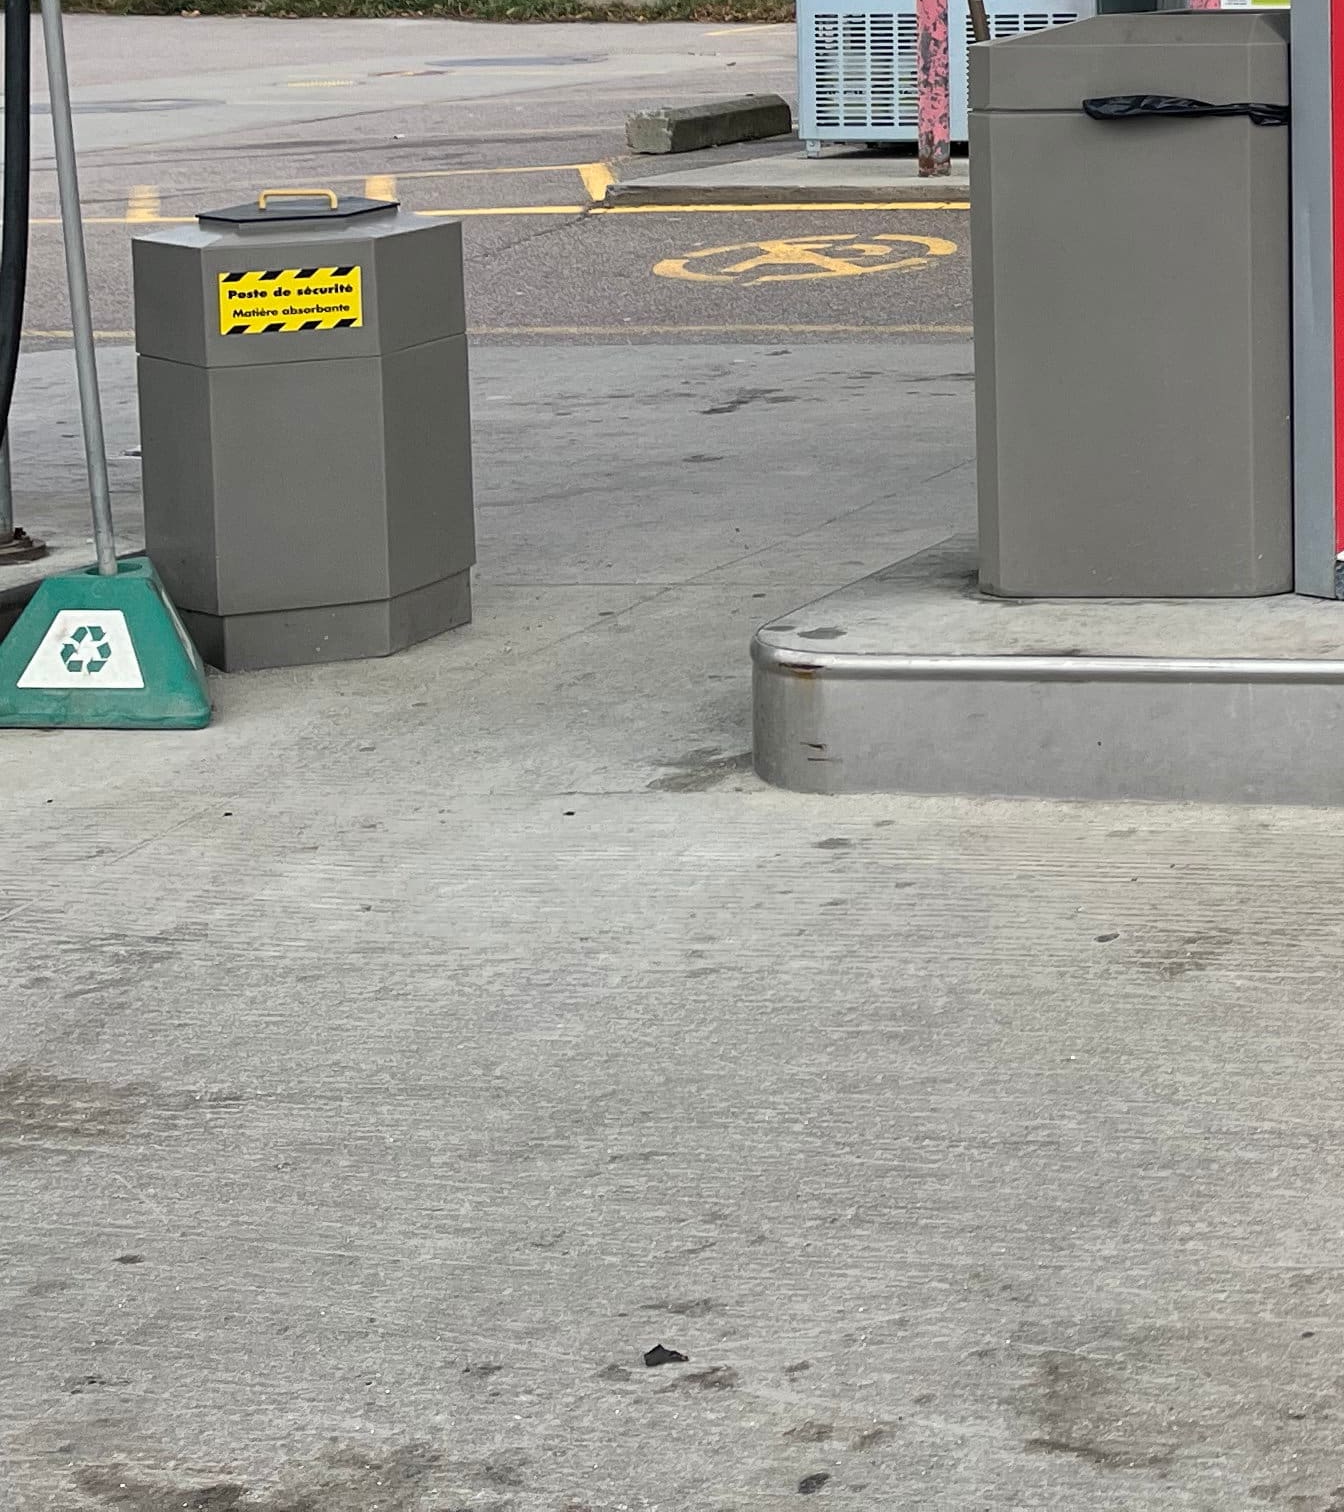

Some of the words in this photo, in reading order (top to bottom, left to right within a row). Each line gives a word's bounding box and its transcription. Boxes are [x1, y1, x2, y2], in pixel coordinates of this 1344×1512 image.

[228, 289, 268, 300] Poste
[273, 287, 291, 297] de
[297, 283, 353, 295] sécurité
[232, 306, 278, 318] Matière
[282, 304, 350, 316] absorbante
